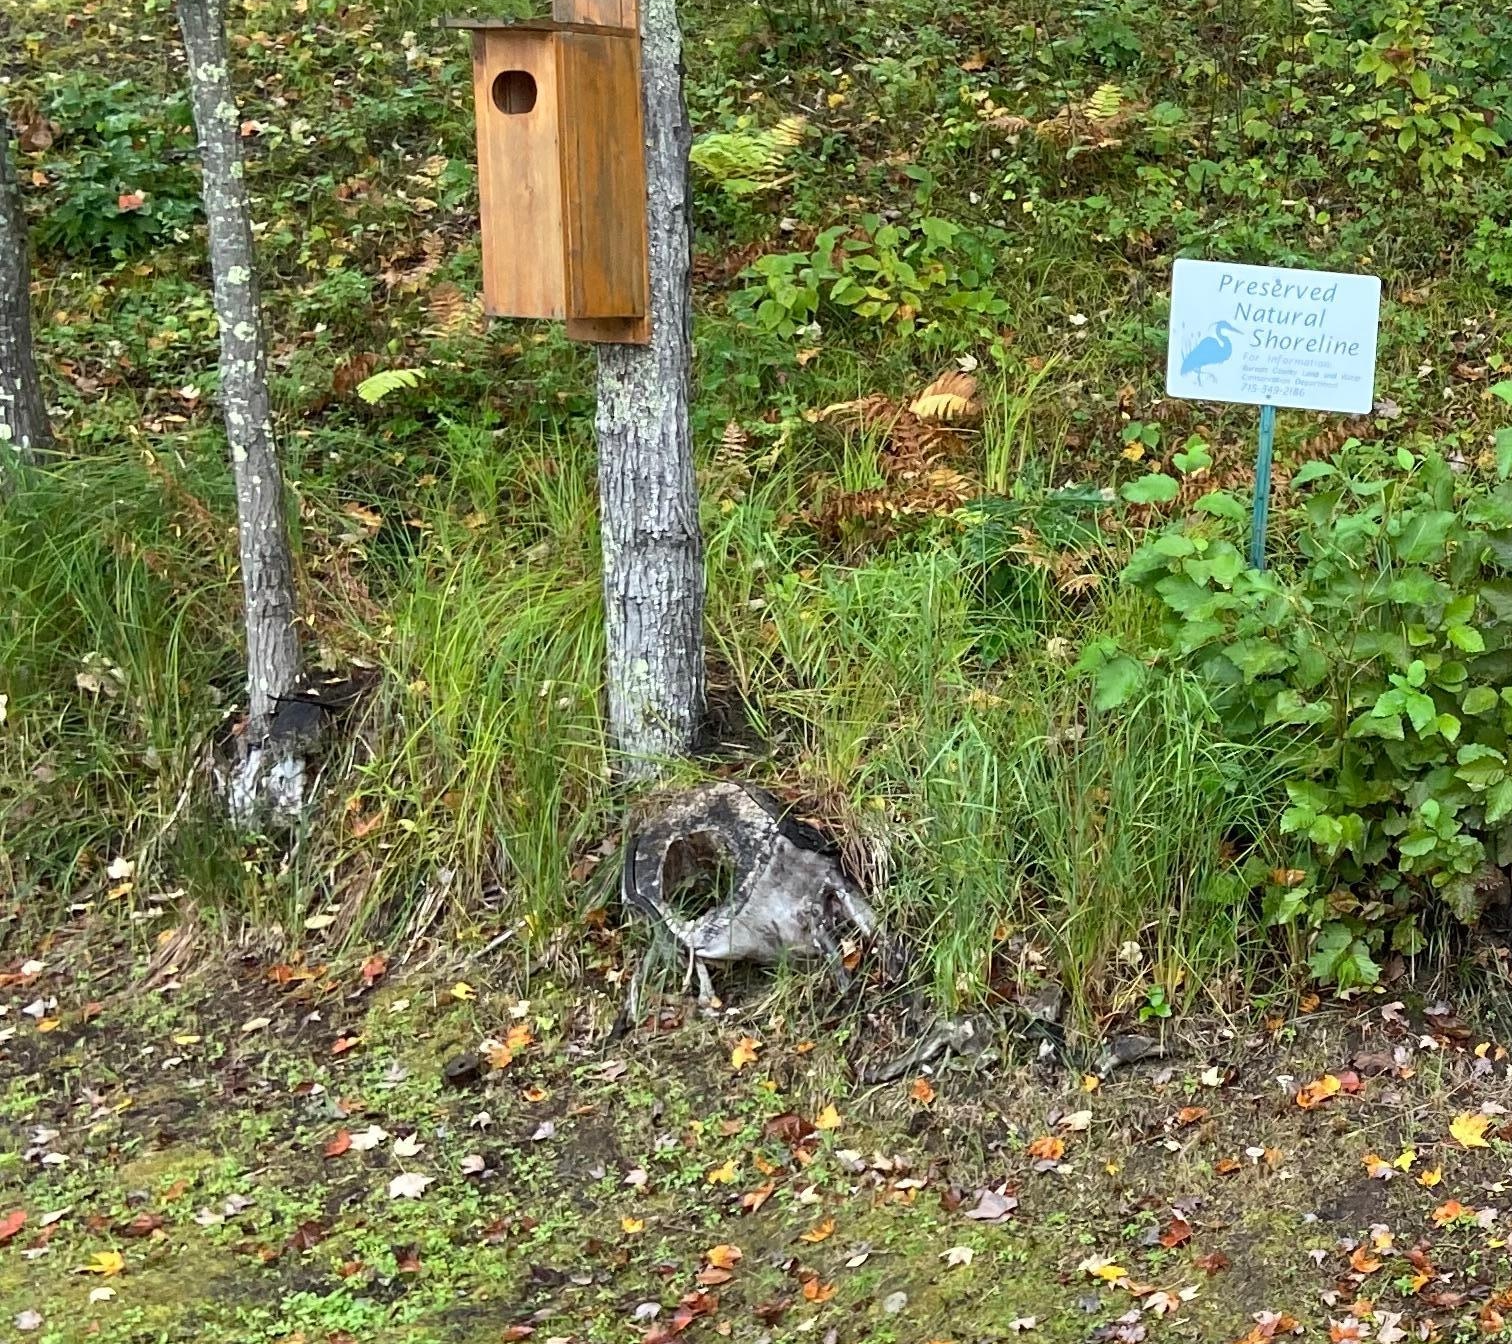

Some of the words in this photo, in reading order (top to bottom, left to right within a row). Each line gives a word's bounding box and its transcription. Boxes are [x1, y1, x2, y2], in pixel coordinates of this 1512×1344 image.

[1219, 274, 1338, 303] Preserved
[1234, 302, 1327, 329] Natural
[1250, 328, 1360, 357] Shoreline
